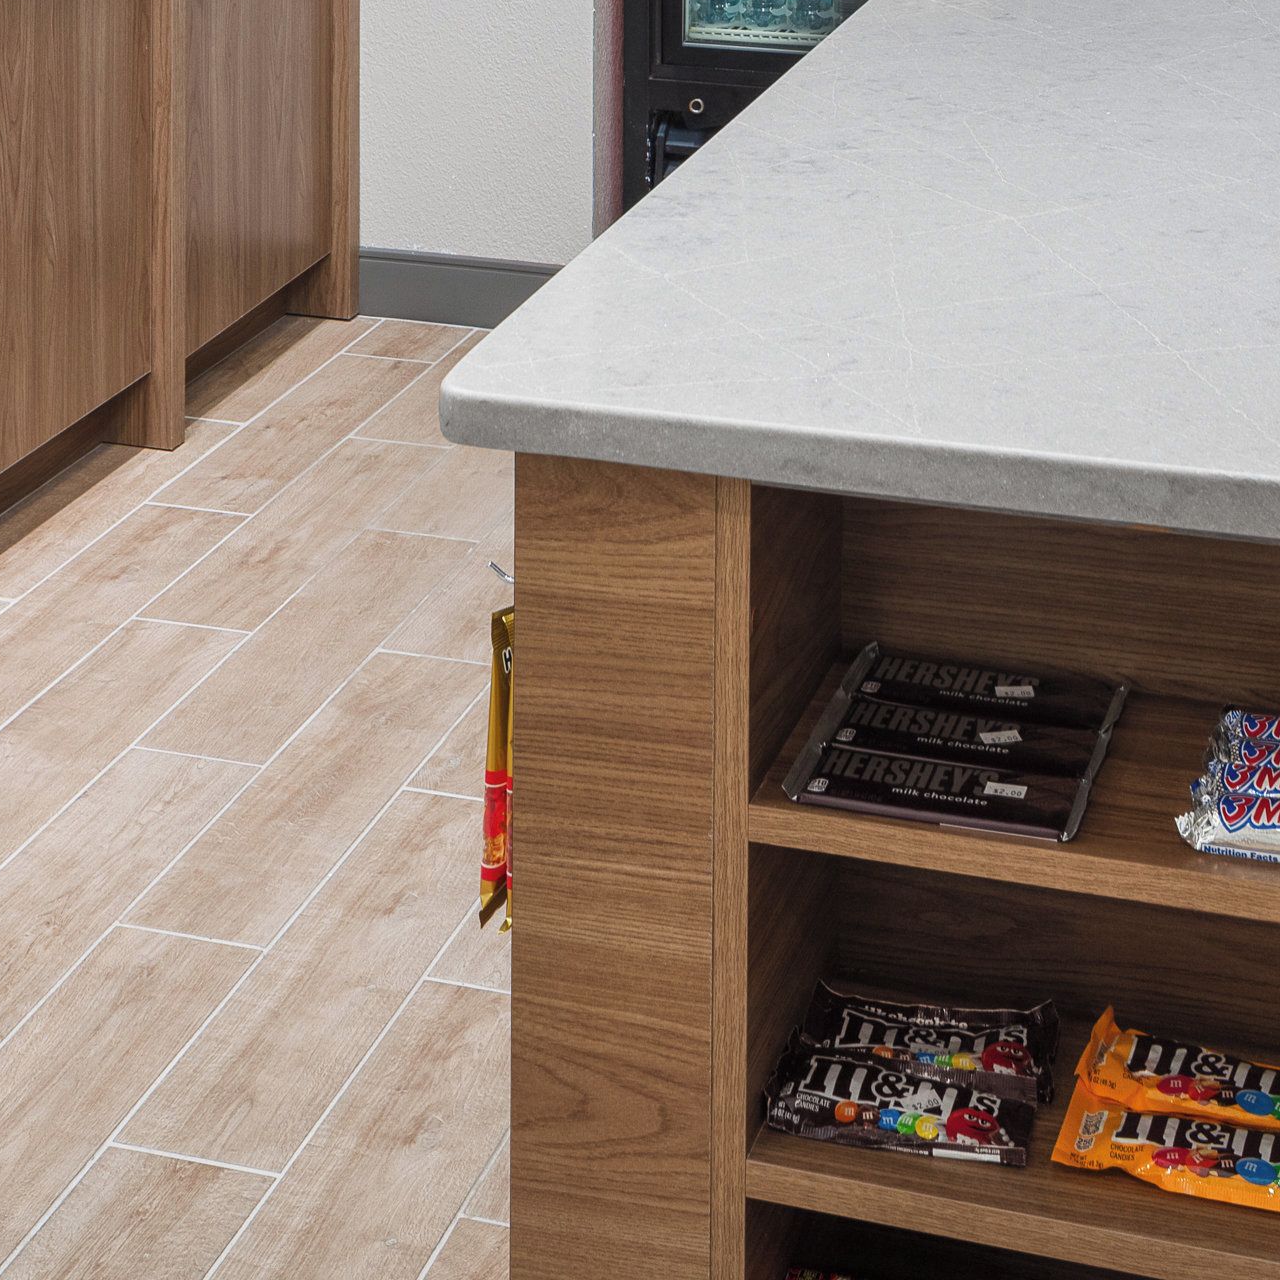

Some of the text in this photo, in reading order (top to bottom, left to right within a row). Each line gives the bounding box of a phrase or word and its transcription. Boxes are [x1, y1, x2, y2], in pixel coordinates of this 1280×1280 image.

[939, 688, 1029, 708] milk chocolate
[1242, 714, 1272, 739] 3
[916, 736, 1010, 755] milk chocolate
[823, 750, 1000, 796] HERSHEY'S
[1224, 764, 1254, 791] 3
[891, 786, 989, 807] milk chocolate
[993, 788, 1022, 798] $2.00
[1220, 795, 1255, 824] 3
[1203, 845, 1279, 864] Nutrition Facts
[796, 1093, 832, 1109] CHOCOLATE
[1109, 1151, 1135, 1162] CANDIES
[1110, 1142, 1145, 1154] CHOCOLATE
